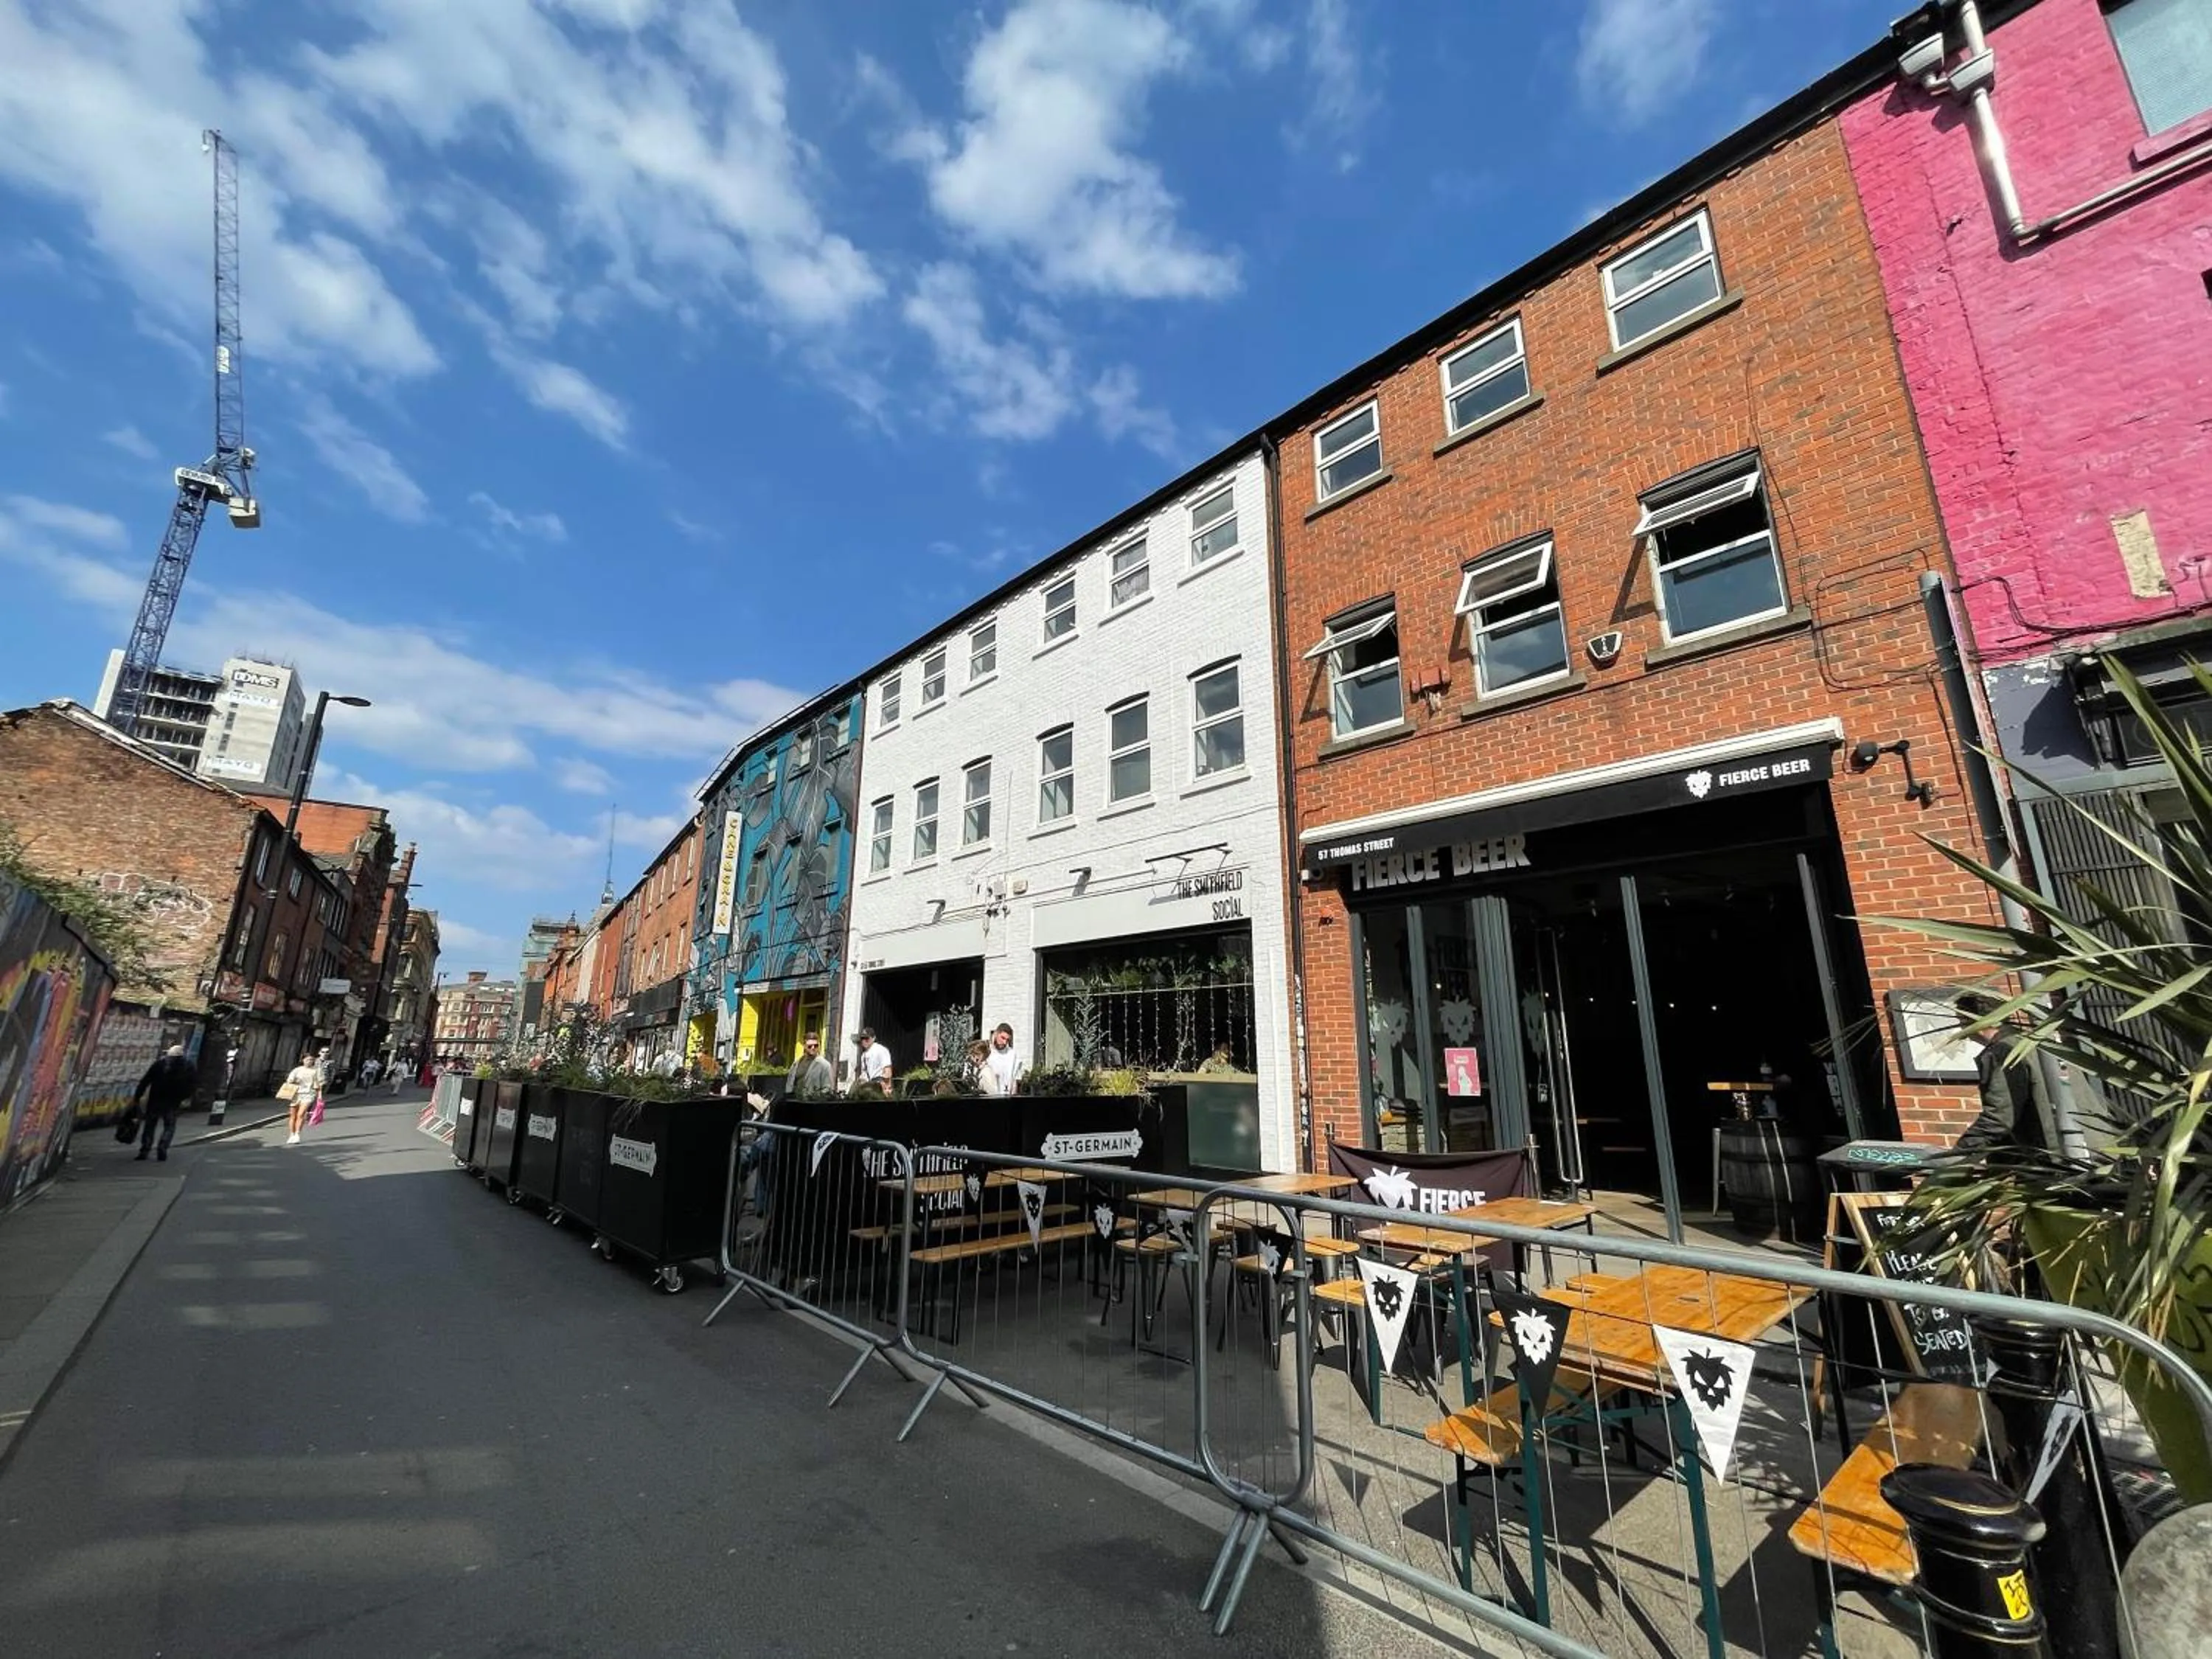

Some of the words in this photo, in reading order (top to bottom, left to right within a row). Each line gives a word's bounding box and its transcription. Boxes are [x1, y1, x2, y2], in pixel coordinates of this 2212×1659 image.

[1719, 766, 1769, 787] FIERCE
[1772, 759, 1811, 778] BEER
[1318, 849, 1328, 860] 57
[1329, 843, 1362, 859] THOMAS
[1363, 837, 1394, 852] STREET
[1352, 849, 1440, 891] FIERCE
[1451, 832, 1531, 876] BEER
[1178, 880, 1192, 900] THE
[1194, 871, 1242, 897] SMITHFIELD
[1211, 897, 1243, 920] SOCIAL
[1054, 1138, 1132, 1154] ST-GERMAIN
[1419, 1187, 1487, 1214] FIERCE
